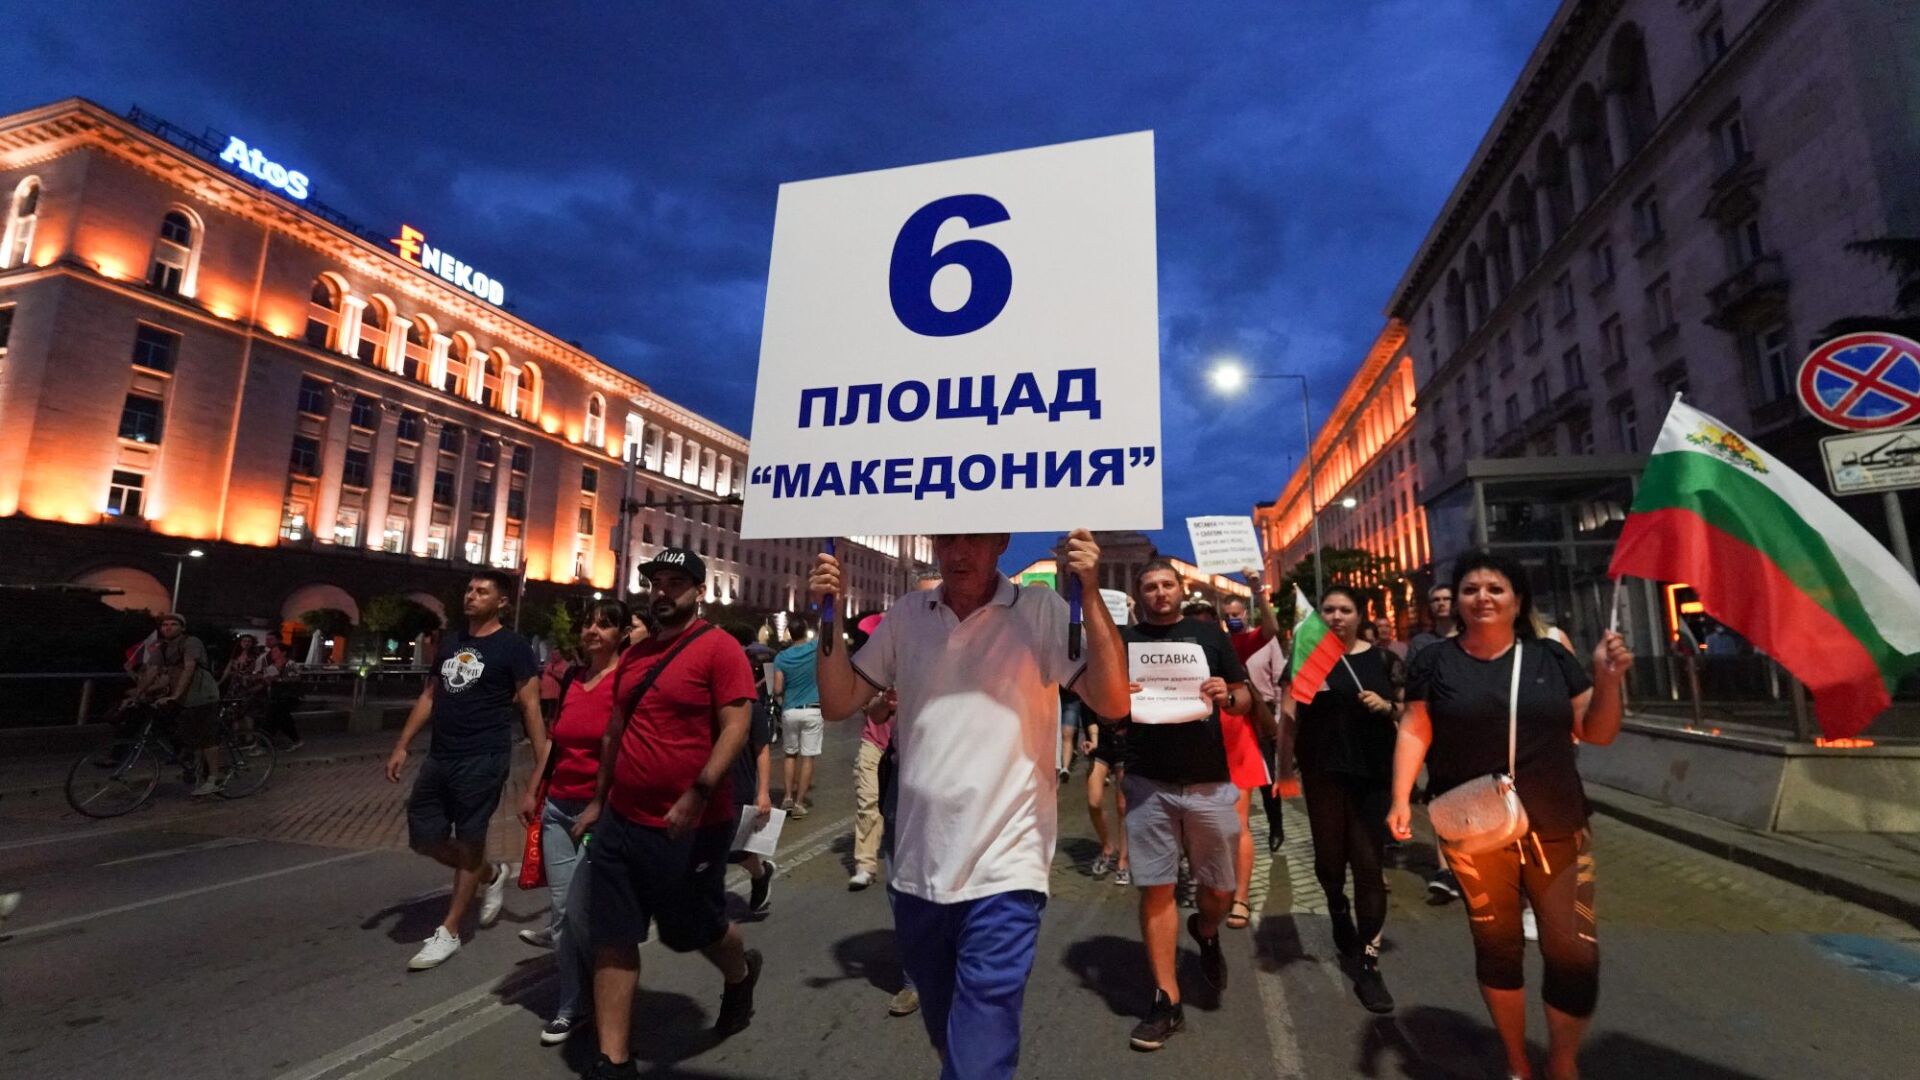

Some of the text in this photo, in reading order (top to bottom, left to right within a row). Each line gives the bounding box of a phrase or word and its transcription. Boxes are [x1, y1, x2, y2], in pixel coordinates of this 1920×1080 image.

[220, 135, 309, 200] Atos
[889, 193, 1013, 337] 6
[798, 367, 1102, 428] ПЛОЩАД
[750, 446, 1156, 500] “МАКЕДОНИЯ”
[1139, 653, 1198, 664] ОСТАВКА
